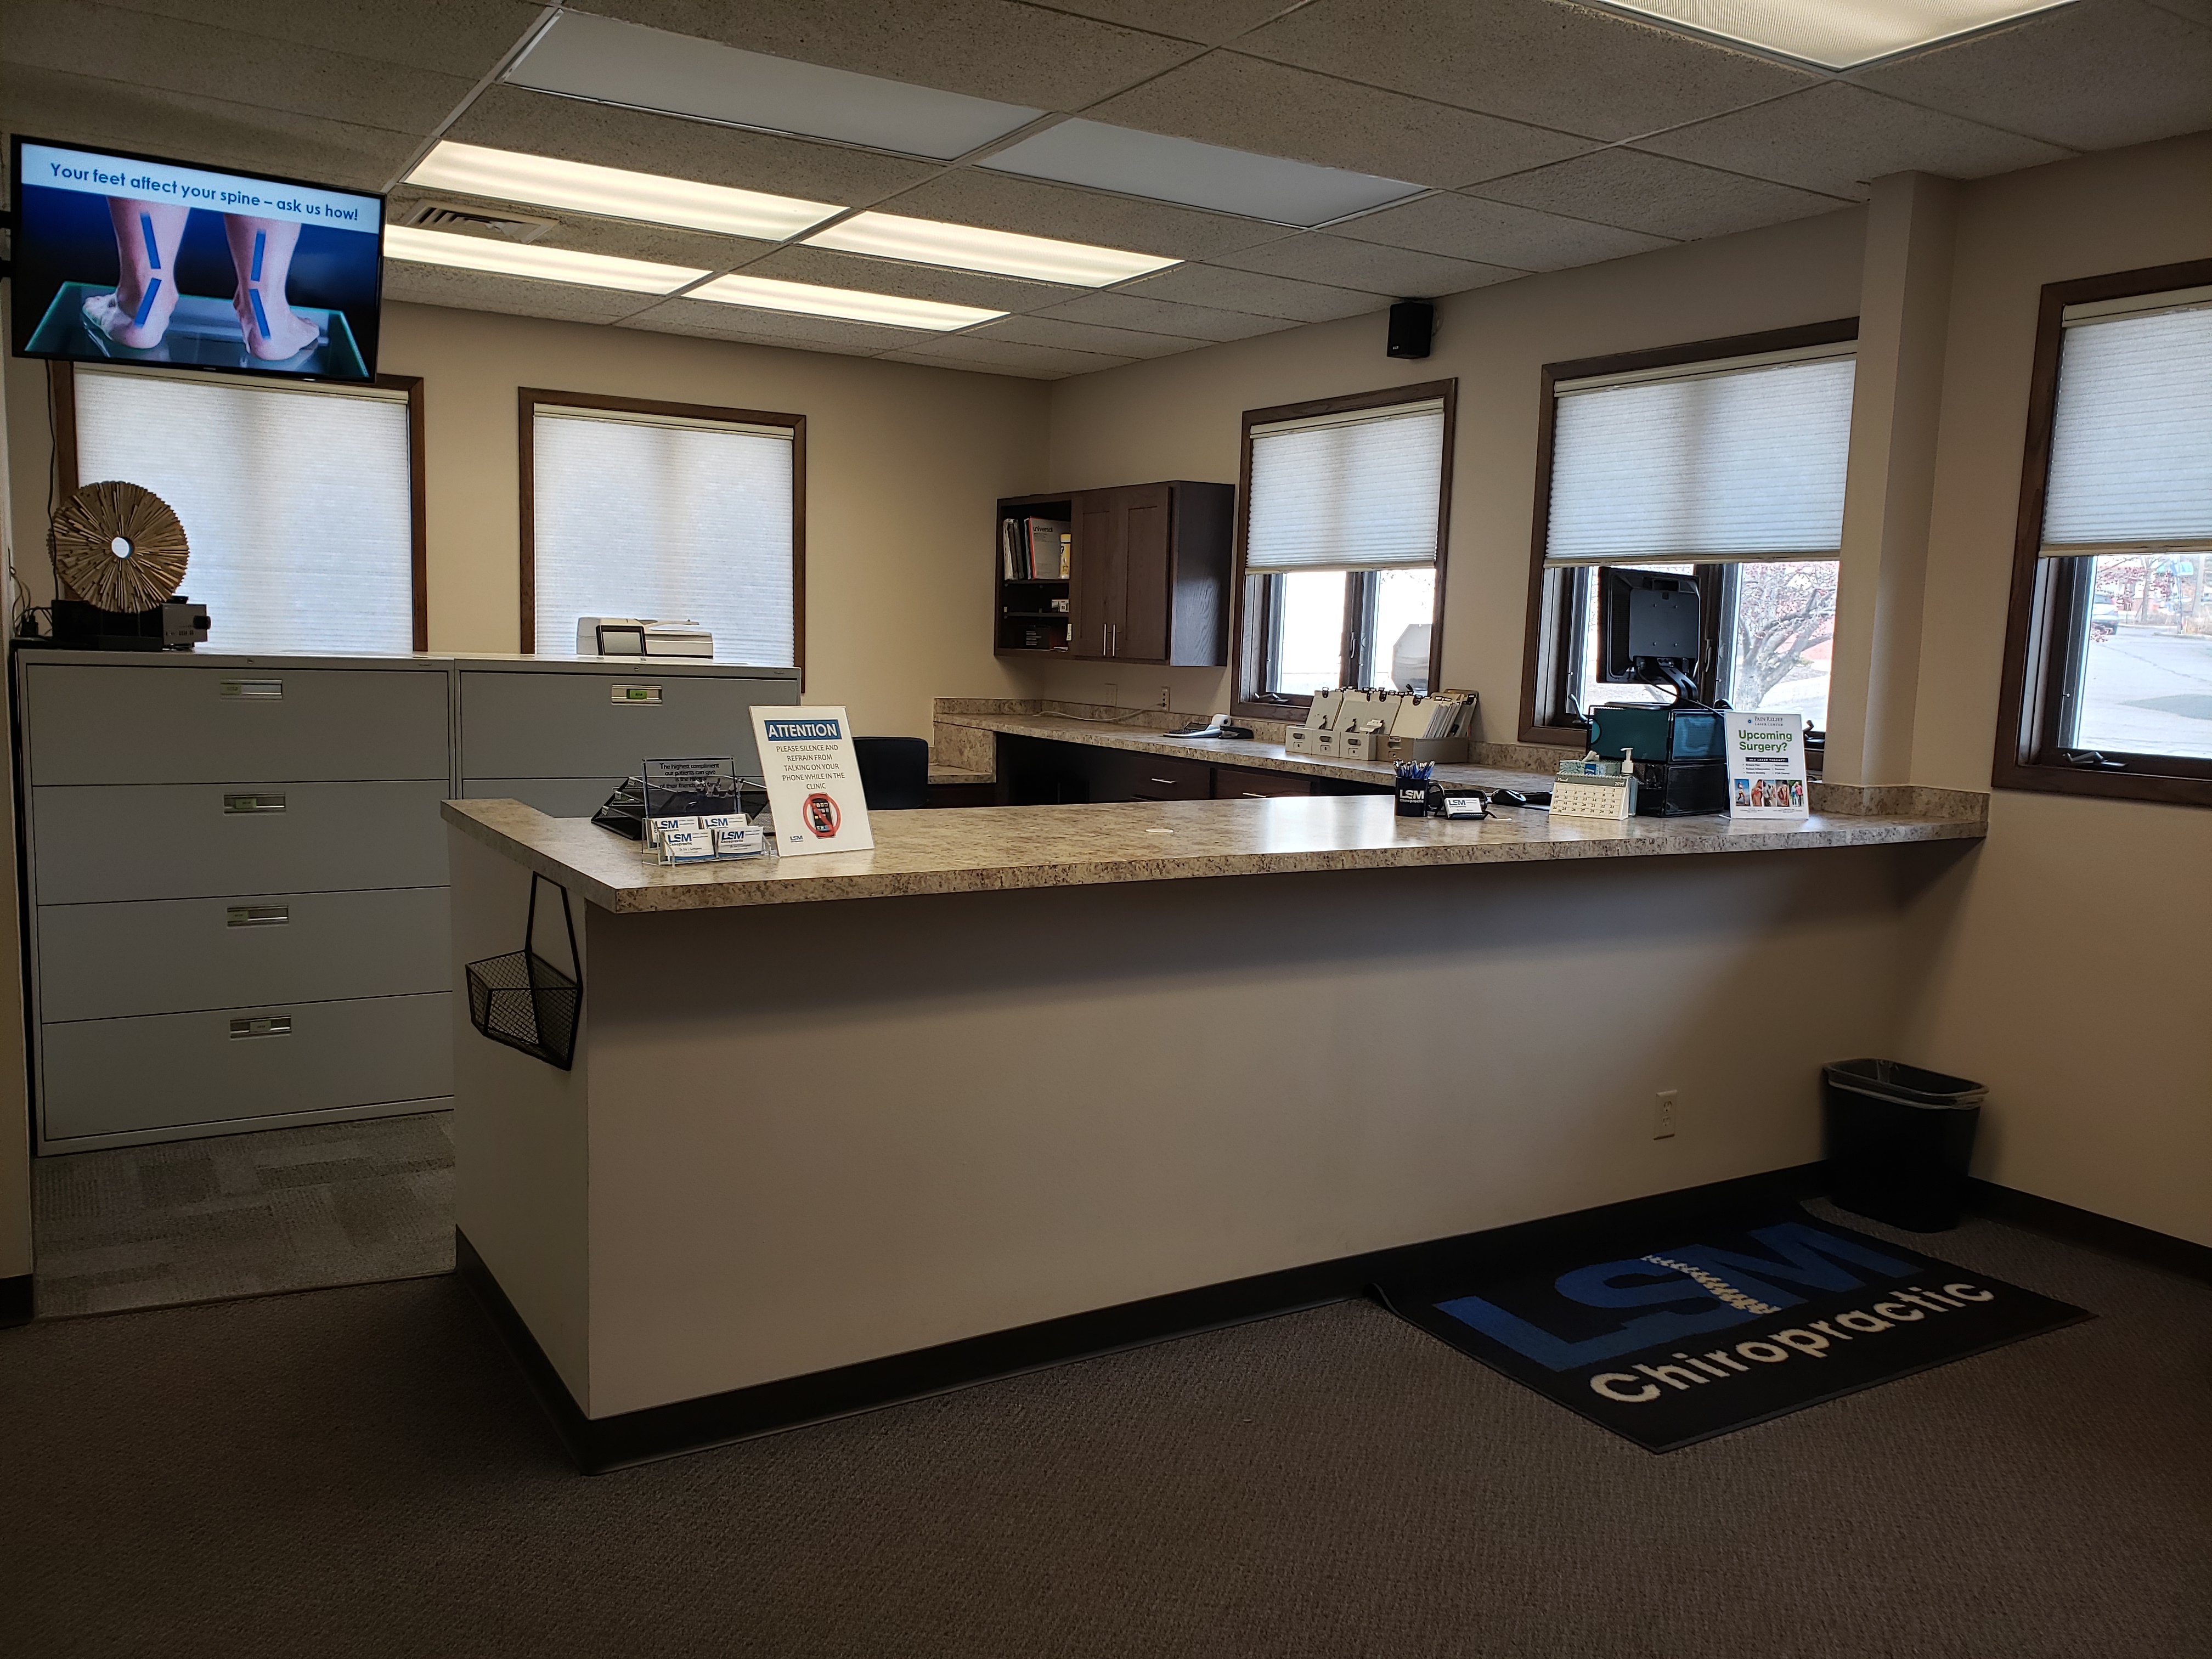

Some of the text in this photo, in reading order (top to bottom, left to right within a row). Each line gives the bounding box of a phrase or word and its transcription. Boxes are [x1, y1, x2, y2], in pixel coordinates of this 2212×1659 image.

[51, 163, 89, 180] Your
[93, 169, 125, 186] feet
[131, 176, 177, 193] affect
[182, 185, 216, 199] your
[221, 191, 260, 205] spine
[277, 199, 301, 212] ask
[307, 205, 320, 215] us
[326, 205, 358, 220] how!
[769, 724, 837, 737] ATTENTION
[1739, 730, 1792, 742] Upcoming
[1740, 742, 1787, 753] Surgery?
[1400, 789, 1424, 799] LSM
[654, 820, 679, 830] LSM
[705, 818, 729, 827] LSM
[668, 833, 692, 843] LSM
[721, 831, 744, 840] LSM
[1431, 1221, 1926, 1373] LSM
[1590, 1280, 1994, 1403] Chiropractic
